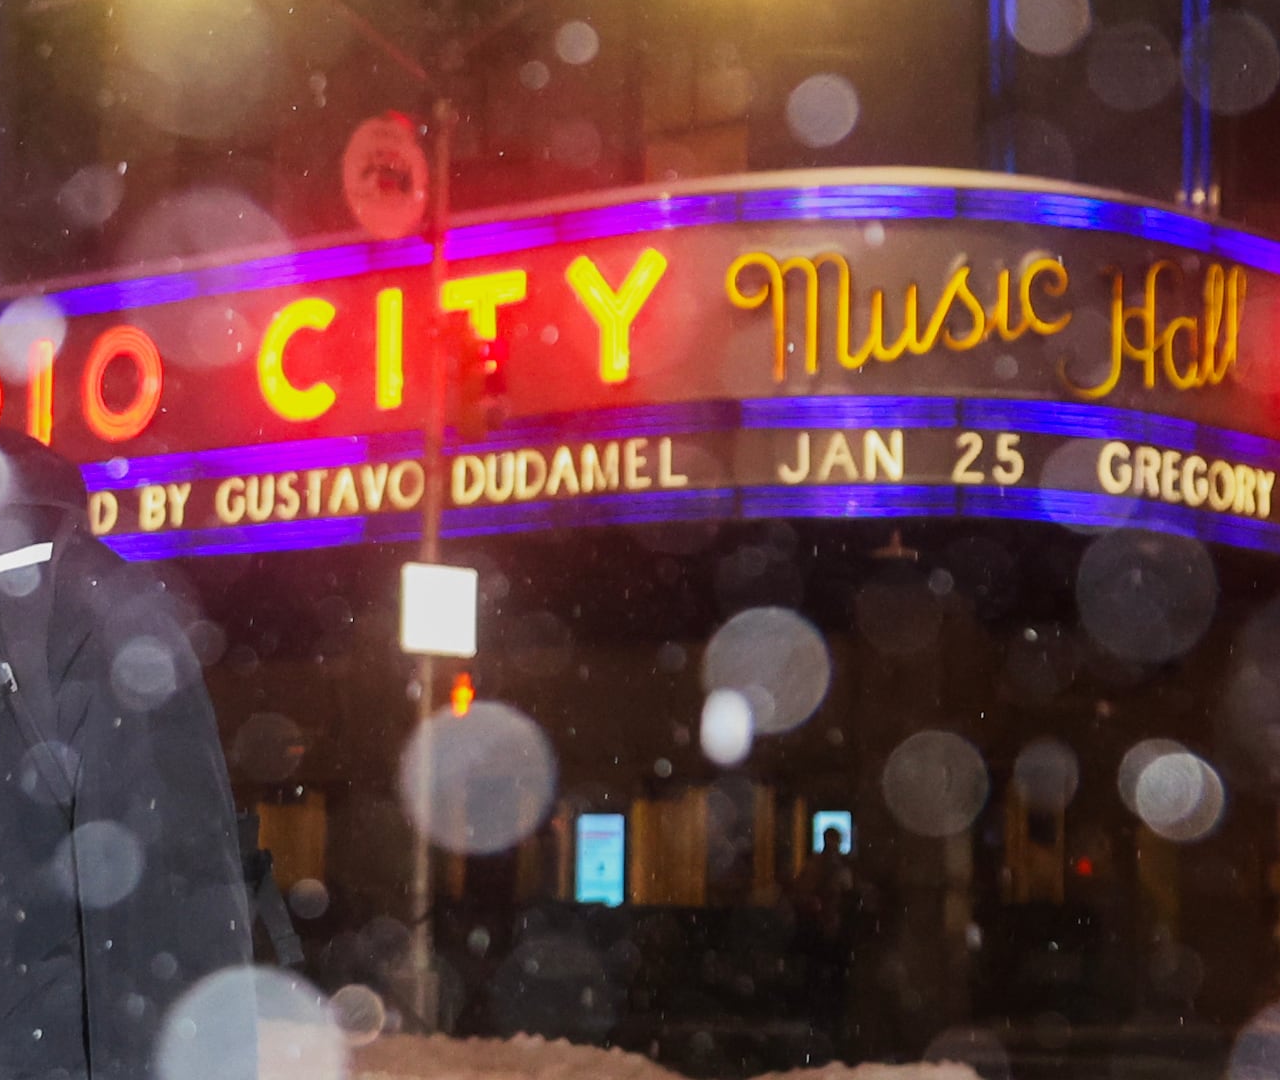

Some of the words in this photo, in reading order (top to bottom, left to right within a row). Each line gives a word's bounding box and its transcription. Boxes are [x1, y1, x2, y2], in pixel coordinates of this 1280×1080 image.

[257, 246, 668, 421] CITY
[725, 248, 1073, 384] Music
[1057, 259, 1247, 399] Hall
[139, 482, 192, 528] BY
[215, 460, 426, 524] GUSTAVO
[450, 436, 689, 506] DUDAMEL
[777, 429, 904, 485] JAN
[951, 431, 1024, 485] 25
[1097, 441, 1276, 519] GREGORY
